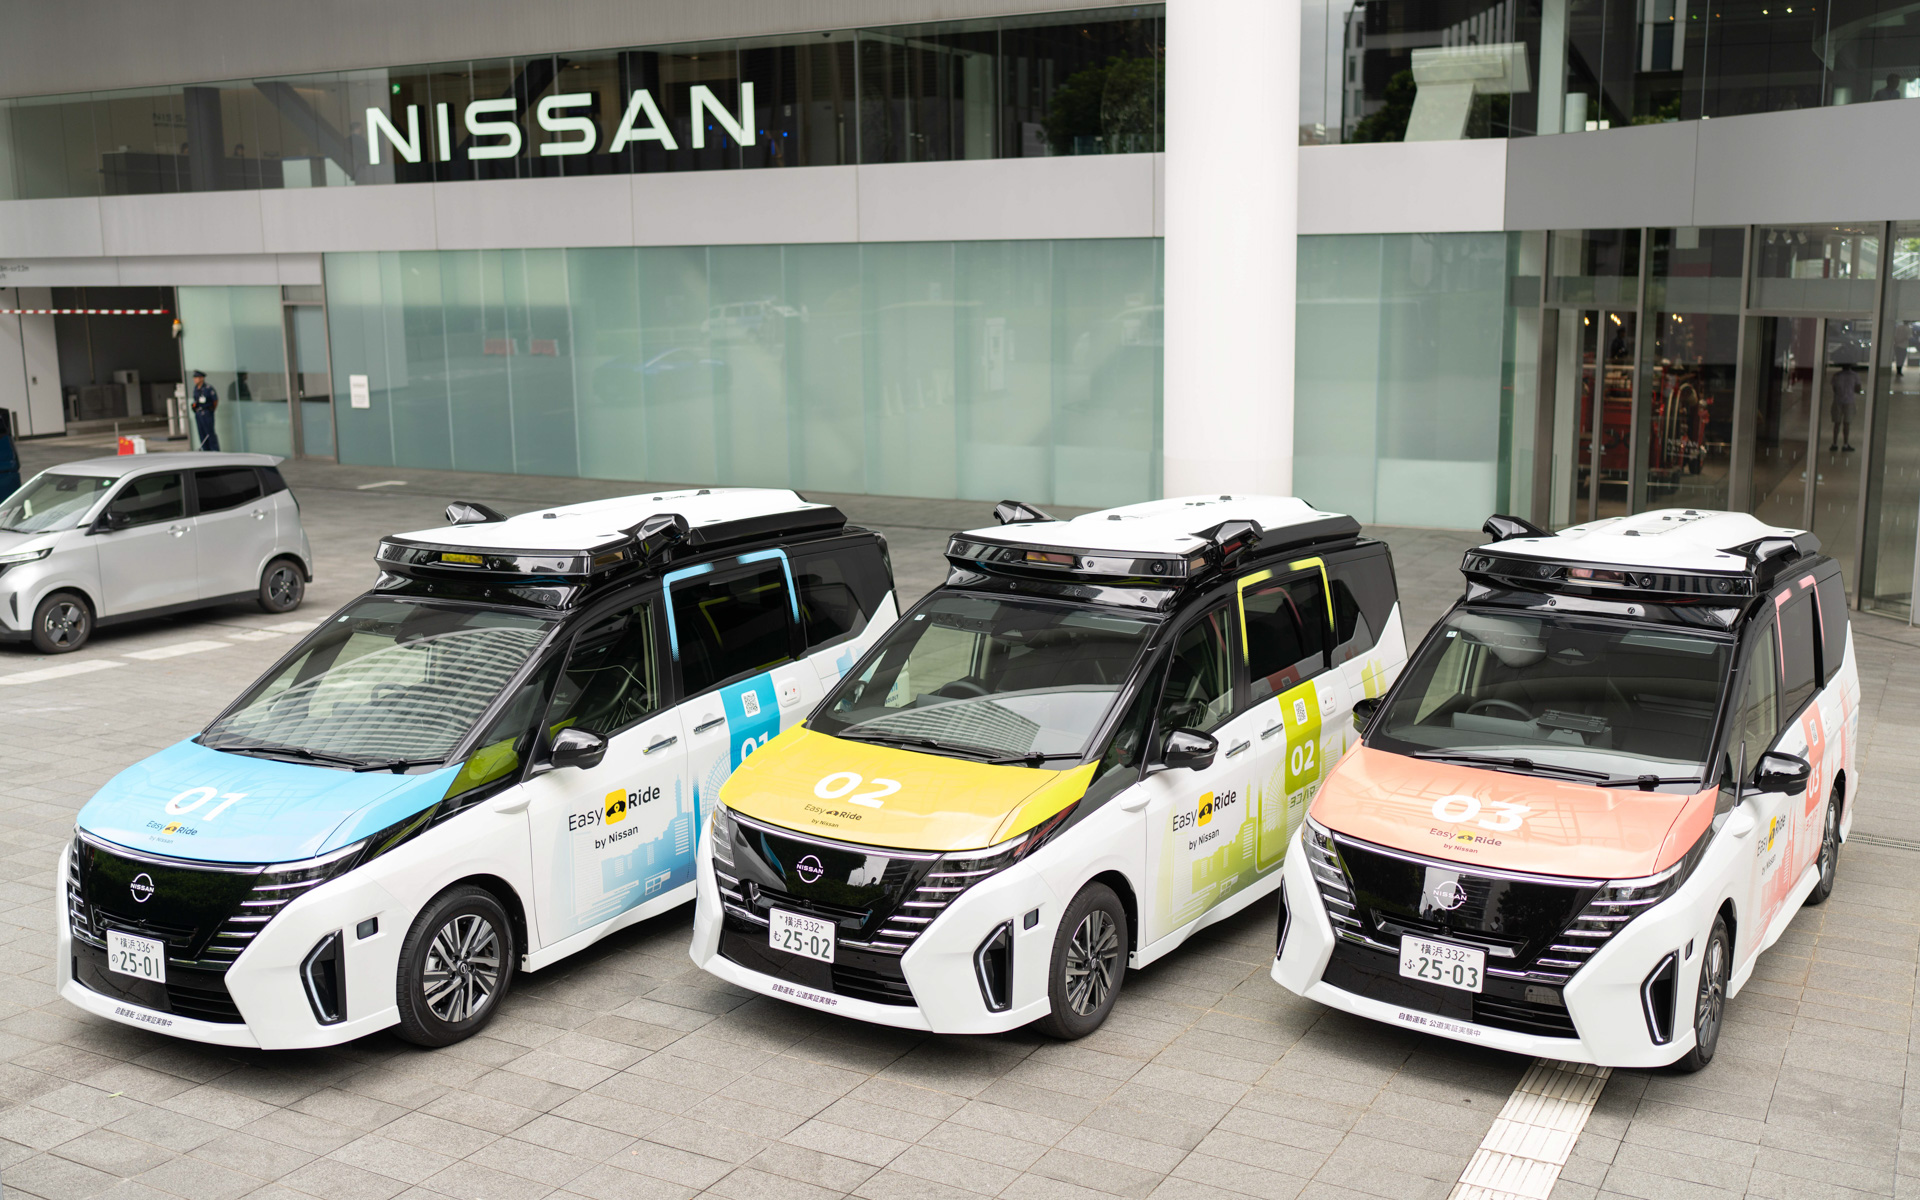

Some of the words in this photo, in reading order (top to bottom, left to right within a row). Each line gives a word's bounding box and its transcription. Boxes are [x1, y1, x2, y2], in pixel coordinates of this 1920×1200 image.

[366, 82, 756, 165] NISSAN
[1291, 739, 1314, 777] 02
[813, 771, 902, 808] 02
[1808, 761, 1819, 799] 03
[165, 786, 249, 821] 01
[567, 807, 604, 831] Easy
[628, 786, 660, 809] Ride
[804, 803, 827, 815] Easy
[839, 811, 862, 821] Ride
[1173, 809, 1197, 832] Easy
[1214, 790, 1236, 812] Ride
[1431, 794, 1532, 832] 03
[146, 820, 166, 832] Easy
[176, 826, 198, 836] Ride
[820, 820, 839, 828] Nissan
[594, 838, 607, 850] by
[608, 825, 639, 844] Nissan
[1189, 839, 1198, 851] by
[1199, 829, 1220, 846] Nissan
[1429, 827, 1457, 839] Easy
[1474, 836, 1502, 847] Ride
[1454, 845, 1479, 854] Nissan
[796, 863, 824, 875] NISSAN
[130, 882, 154, 893] NISSAN
[1433, 889, 1468, 901] NISSAN
[783, 928, 830, 960] 25-02
[111, 954, 118, 964] の
[120, 950, 159, 979] 25-01
[1404, 959, 1416, 970] ふ
[1417, 957, 1478, 988] 25-03
[771, 983, 795, 996] 自動運転
[796, 990, 838, 1006] 公道実証実験中
[114, 1006, 136, 1019] 自動運転
[1398, 1012, 1427, 1026] 自動運転
[1429, 1019, 1482, 1038] 公道実証実験中
